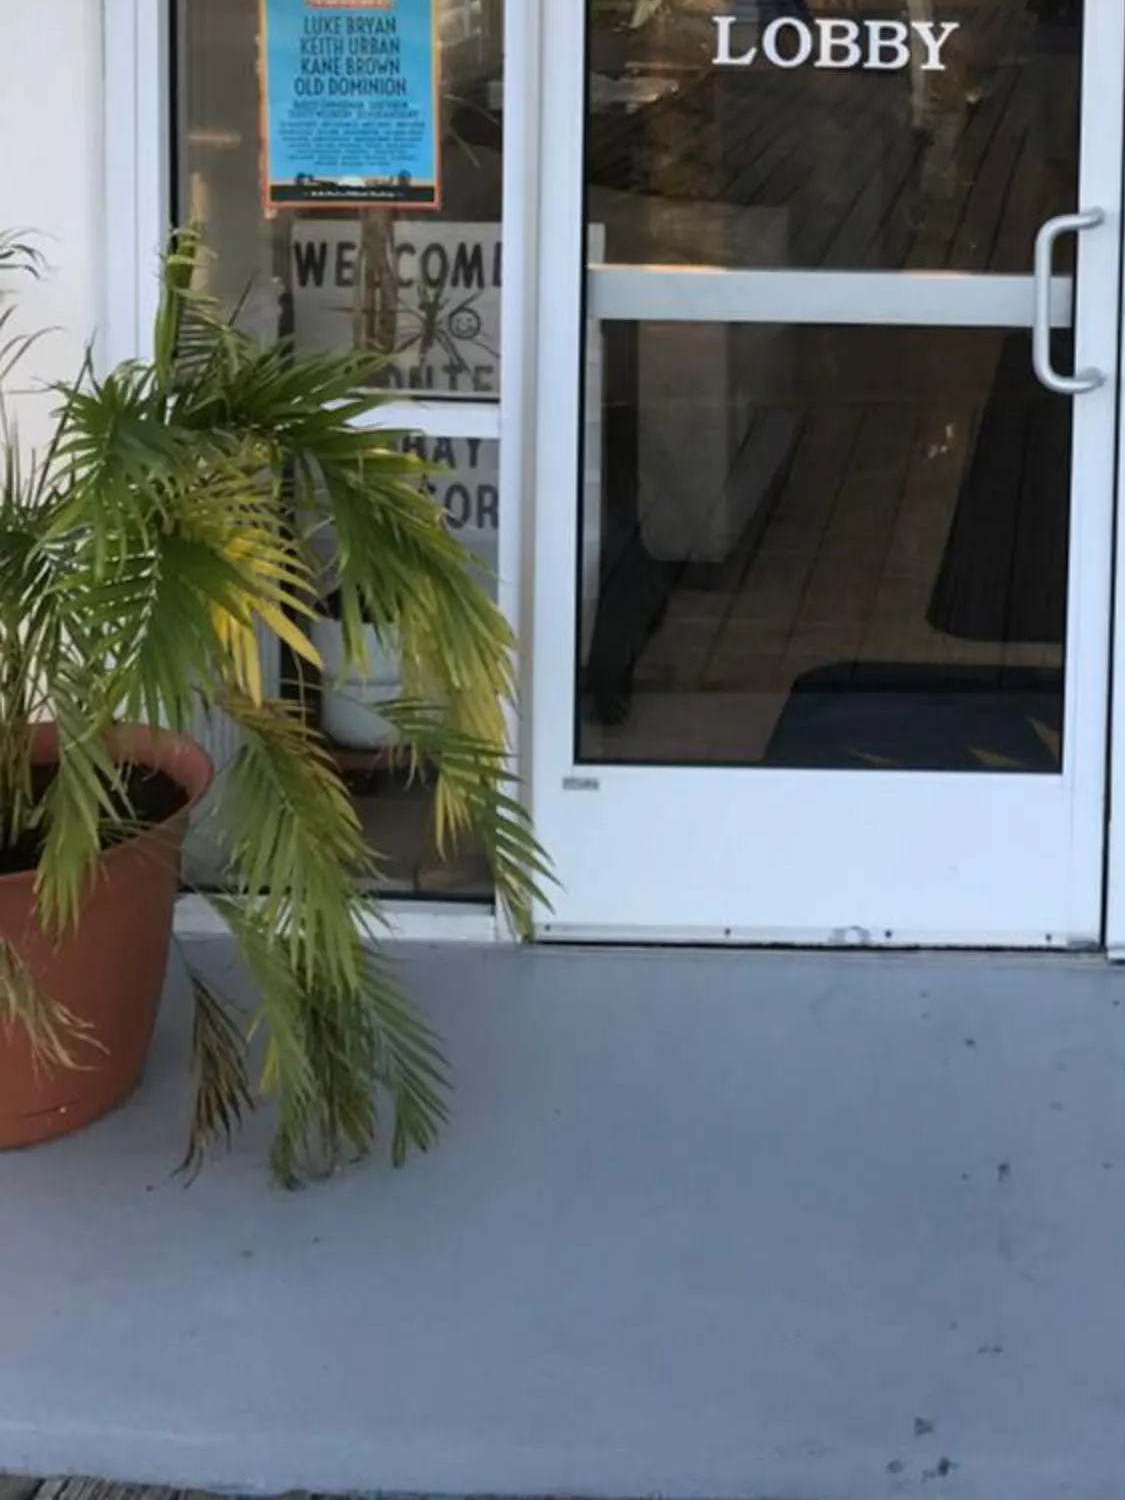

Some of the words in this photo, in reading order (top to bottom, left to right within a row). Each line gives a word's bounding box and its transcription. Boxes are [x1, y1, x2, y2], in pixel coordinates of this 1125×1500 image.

[303, 16, 343, 35] LUKE
[346, 16, 397, 35] BRYAN
[301, 37, 344, 55] KEITH
[349, 36, 400, 55] URBAN
[712, 15, 960, 70] LOBBY
[301, 57, 342, 76] KANE
[346, 57, 401, 76] BROWN
[294, 78, 324, 97] OLD
[328, 78, 407, 97] DOMINION
[294, 240, 503, 288] WECOM
